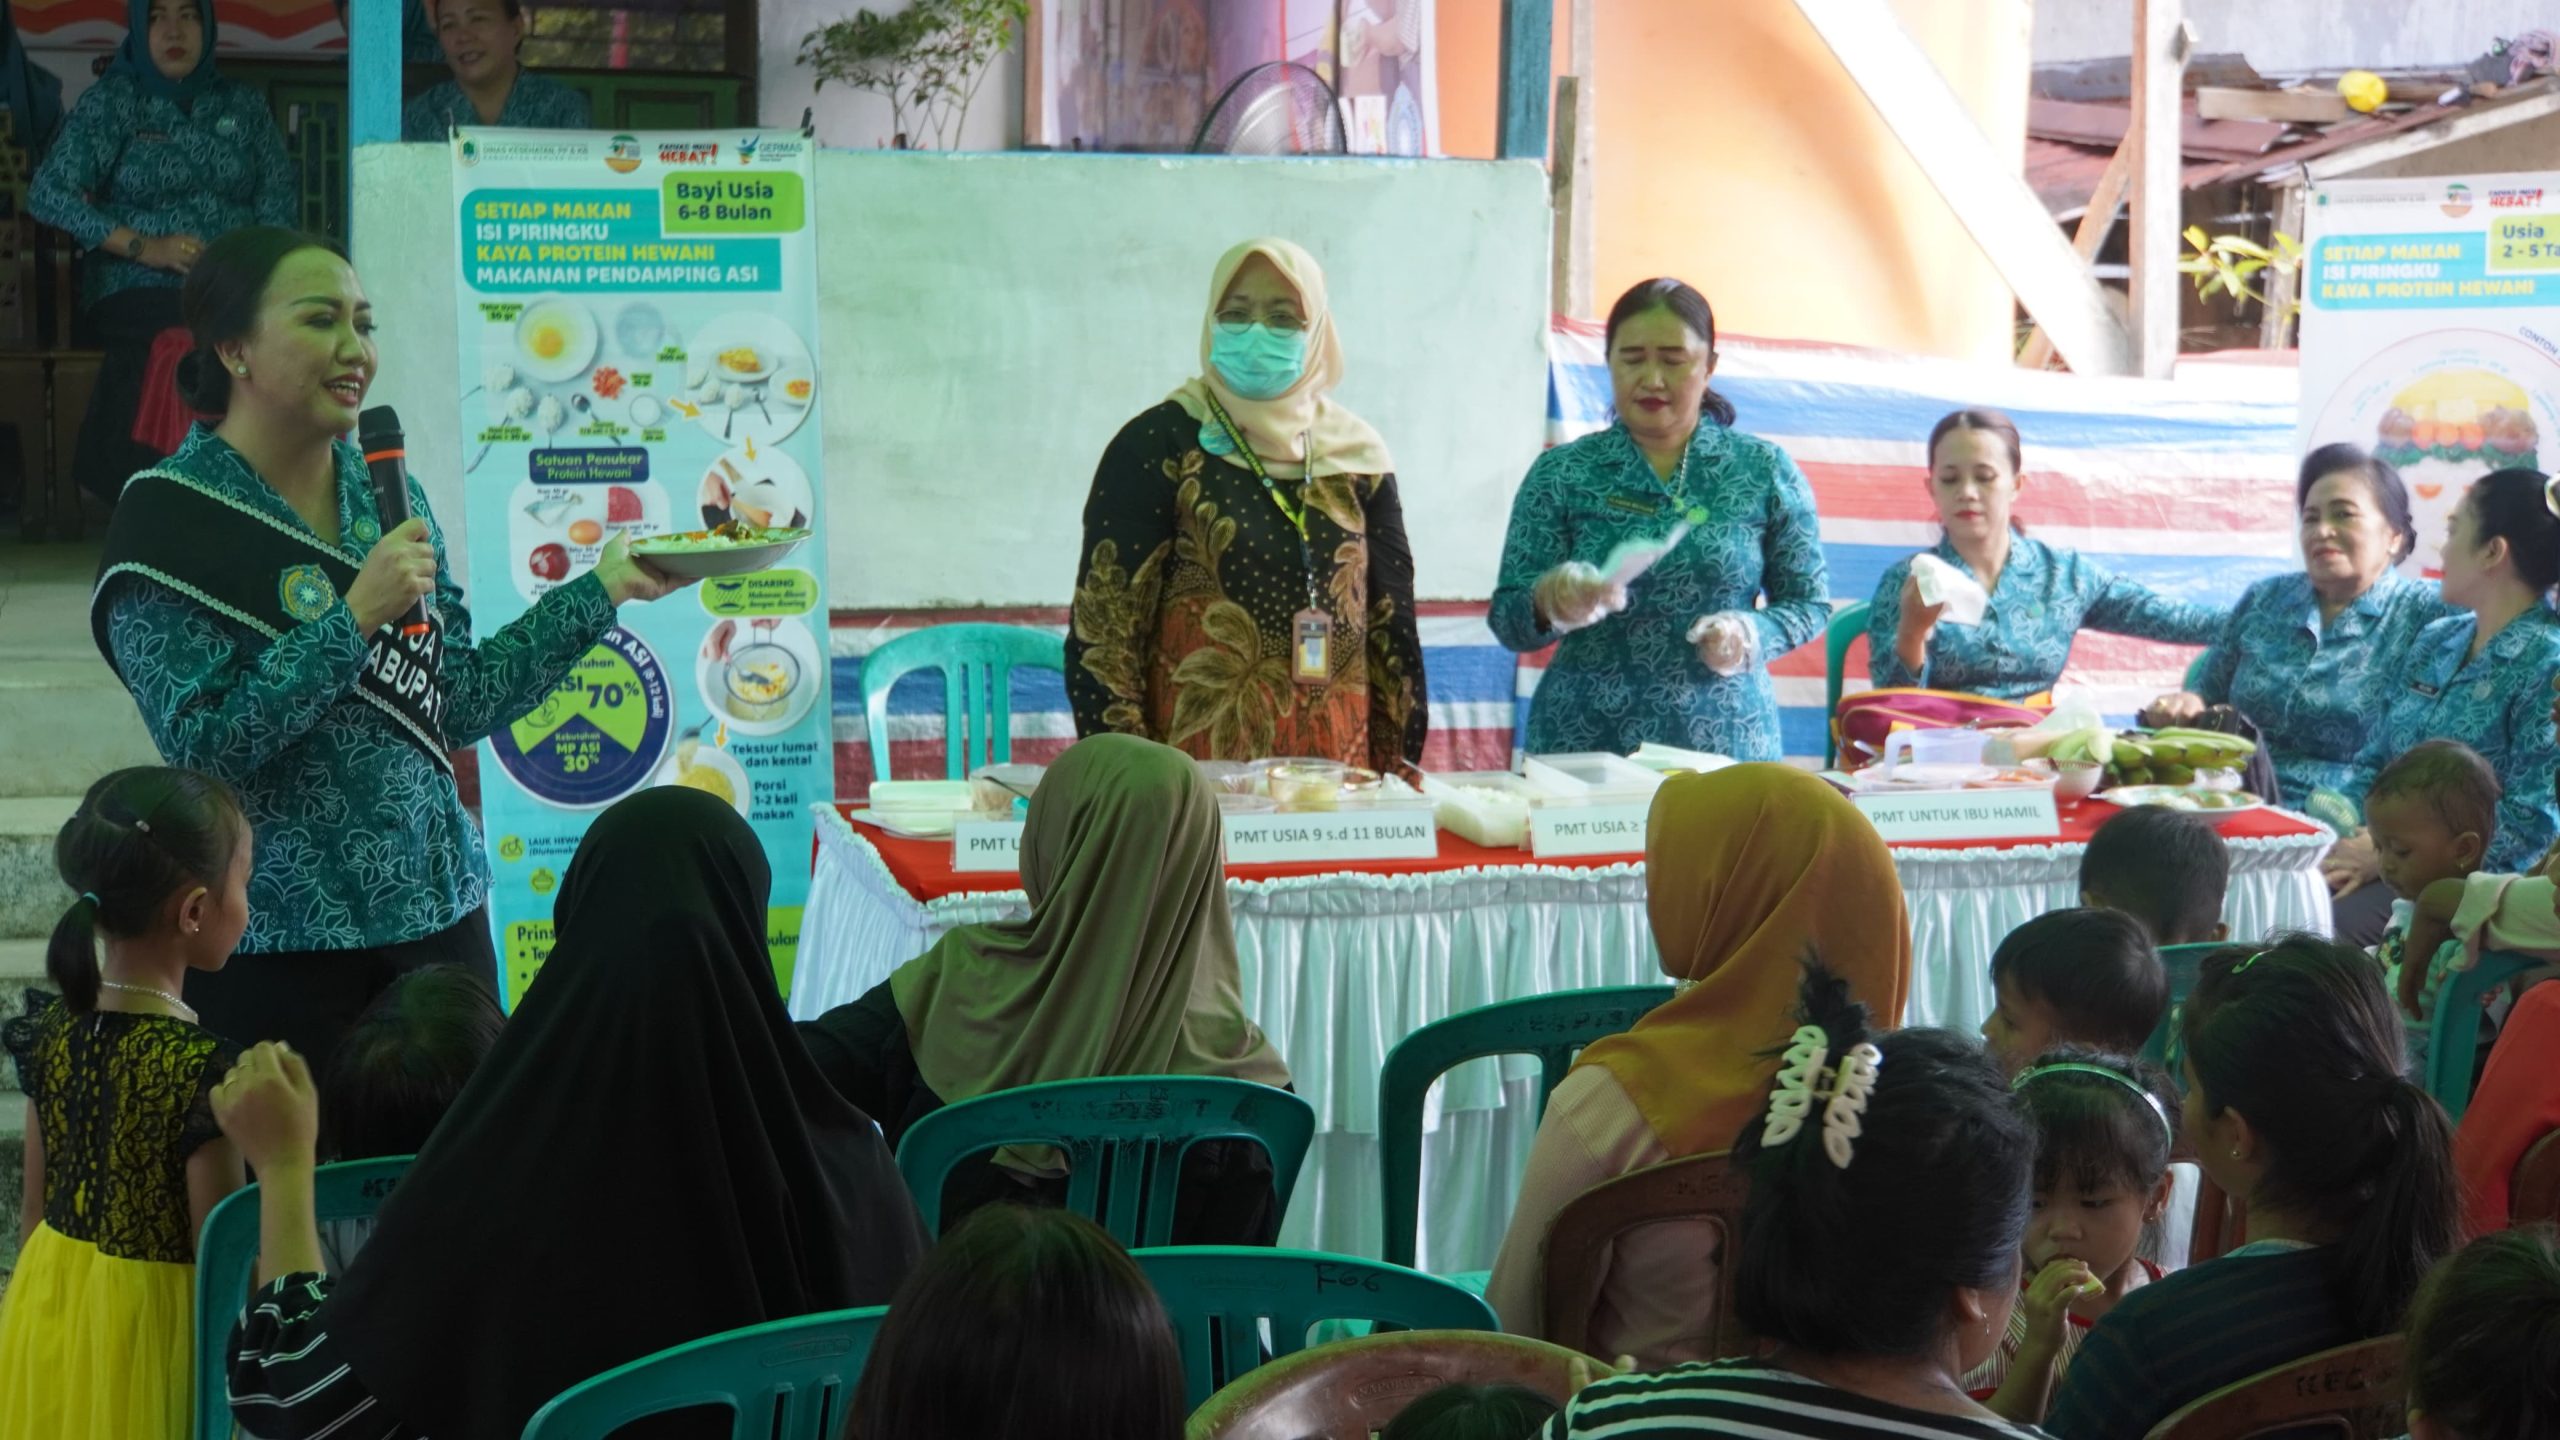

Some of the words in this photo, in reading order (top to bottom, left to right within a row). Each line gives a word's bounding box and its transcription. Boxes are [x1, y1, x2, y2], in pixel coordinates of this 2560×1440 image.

[677, 182, 722, 202] Bayi
[728, 181, 774, 200] Usia
[475, 203, 546, 219] SETIAP
[552, 203, 631, 219] MAKAN
[678, 204, 710, 221] 6-8
[716, 204, 772, 220] Bulan
[476, 224, 501, 240] ISI
[508, 224, 609, 240] PIRINGKU
[2503, 223, 2545, 239] Usia
[477, 245, 532, 261] KAYA
[539, 245, 626, 261] PROTEIN
[632, 244, 715, 261] HEWANI
[2323, 245, 2386, 261] SETIAP
[2391, 243, 2461, 260] MAKAN
[2503, 244, 2513, 258] 2
[2529, 244, 2539, 257] 5
[477, 267, 581, 283] MAKANAN
[587, 266, 720, 283] PENDAMPING
[726, 266, 758, 282] ASI
[2323, 265, 2345, 280] ISI
[2351, 263, 2440, 279] PIRINGKU
[2322, 282, 2370, 298] KAYA
[2375, 281, 2453, 297] PROTEIN
[2459, 280, 2535, 296] HEWANI
[2519, 326, 2558, 355] CONTOH
[536, 453, 582, 467] Satuan
[587, 451, 643, 465] Penukar
[548, 467, 586, 480] Protein
[590, 466, 632, 479] Hewani
[748, 579, 794, 588] DISARING
[623, 640, 651, 667] ASI
[555, 732, 600, 741] Kebutuhan
[556, 743, 576, 754] MP
[579, 742, 600, 753] ASI
[732, 743, 779, 755] Tekstur
[782, 741, 819, 752] lumat
[564, 752, 600, 773] 30%
[745, 756, 769, 768] dan
[772, 754, 812, 766] kental
[755, 778, 786, 791] Porsi
[755, 794, 772, 806] 1-2
[775, 793, 798, 805] kali
[752, 809, 794, 821] makan
[1873, 810, 1905, 823] PMT
[1909, 809, 1960, 821] UNTUK
[1964, 808, 1989, 820] IBU
[1993, 806, 2041, 819] HAMIL
[1234, 829, 1268, 843] PMT
[1273, 828, 1308, 842] USIA
[1313, 828, 1322, 841] 9
[1326, 826, 1347, 841] s.d
[1353, 827, 1369, 840] 11
[1375, 826, 1426, 840] BULAN
[1554, 822, 1588, 836] PMT
[1592, 821, 1626, 834] USIA
[529, 837, 551, 847] LAUK
[970, 837, 1005, 850] PMT
[768, 929, 799, 946] ulan
